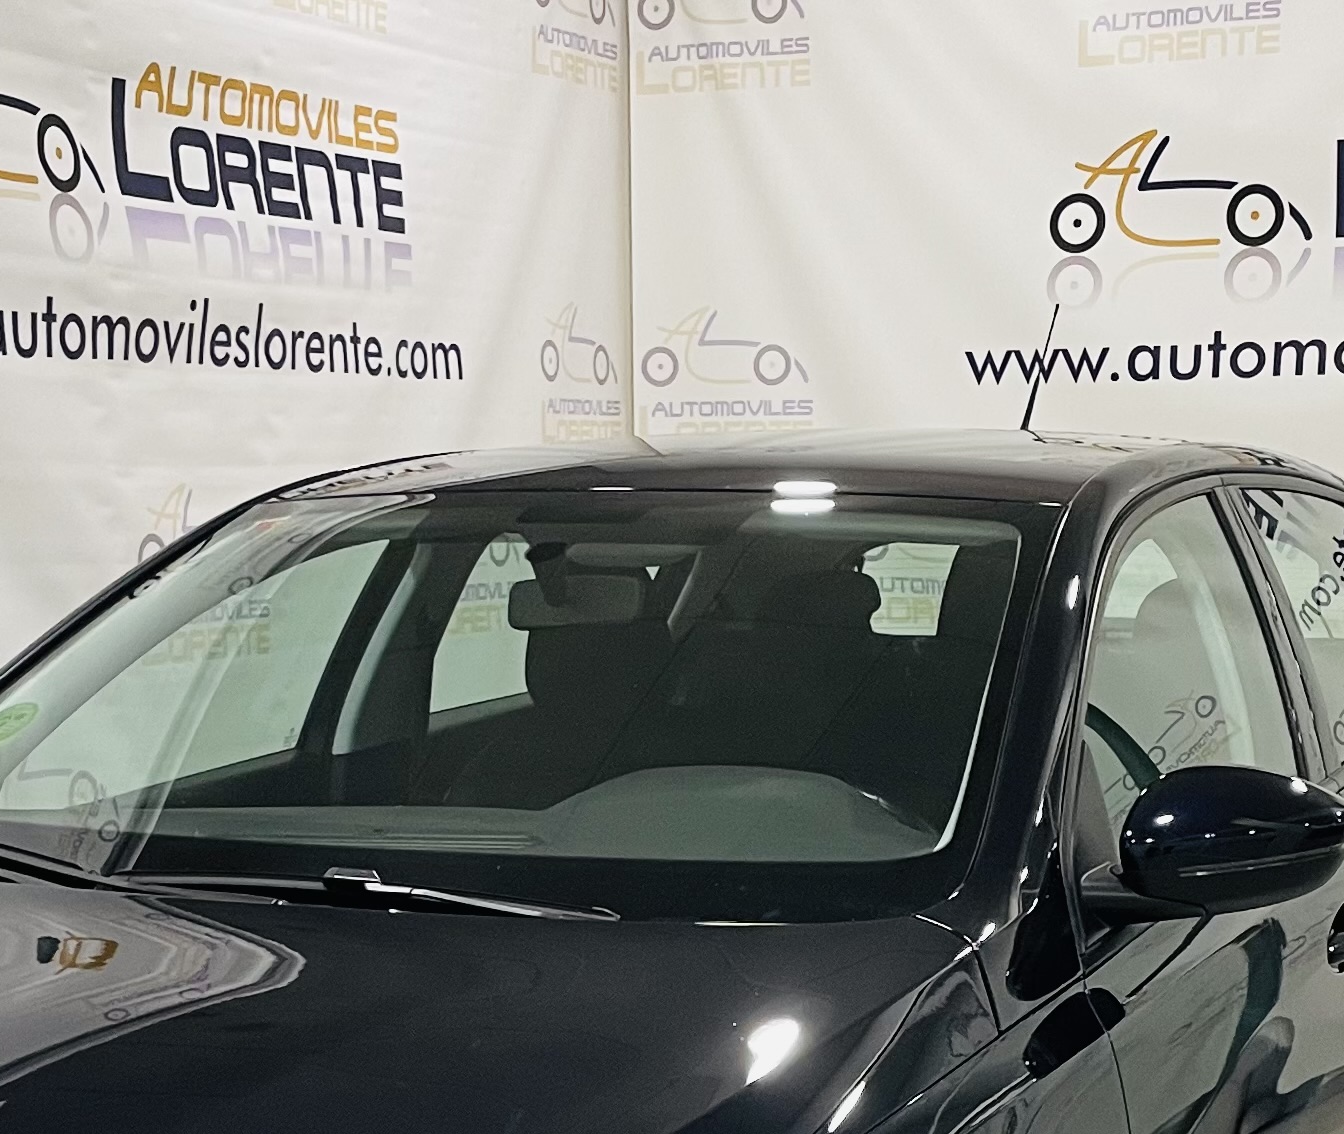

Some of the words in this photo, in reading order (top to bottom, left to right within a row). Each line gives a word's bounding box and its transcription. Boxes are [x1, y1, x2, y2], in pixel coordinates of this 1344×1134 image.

[1092, 1, 1281, 32] AUTOMOVILES
[531, 27, 619, 94] LORENTE
[537, 23, 618, 61] AUTOMOVILES
[648, 36, 810, 62] AUTOMOVILES
[1078, 21, 1280, 67] LORENTE
[636, 50, 811, 96] LORENTE
[135, 62, 398, 153] AUTOMOVILES
[111, 77, 406, 234] LORENTE
[651, 399, 813, 417] AUTOMOVILES
